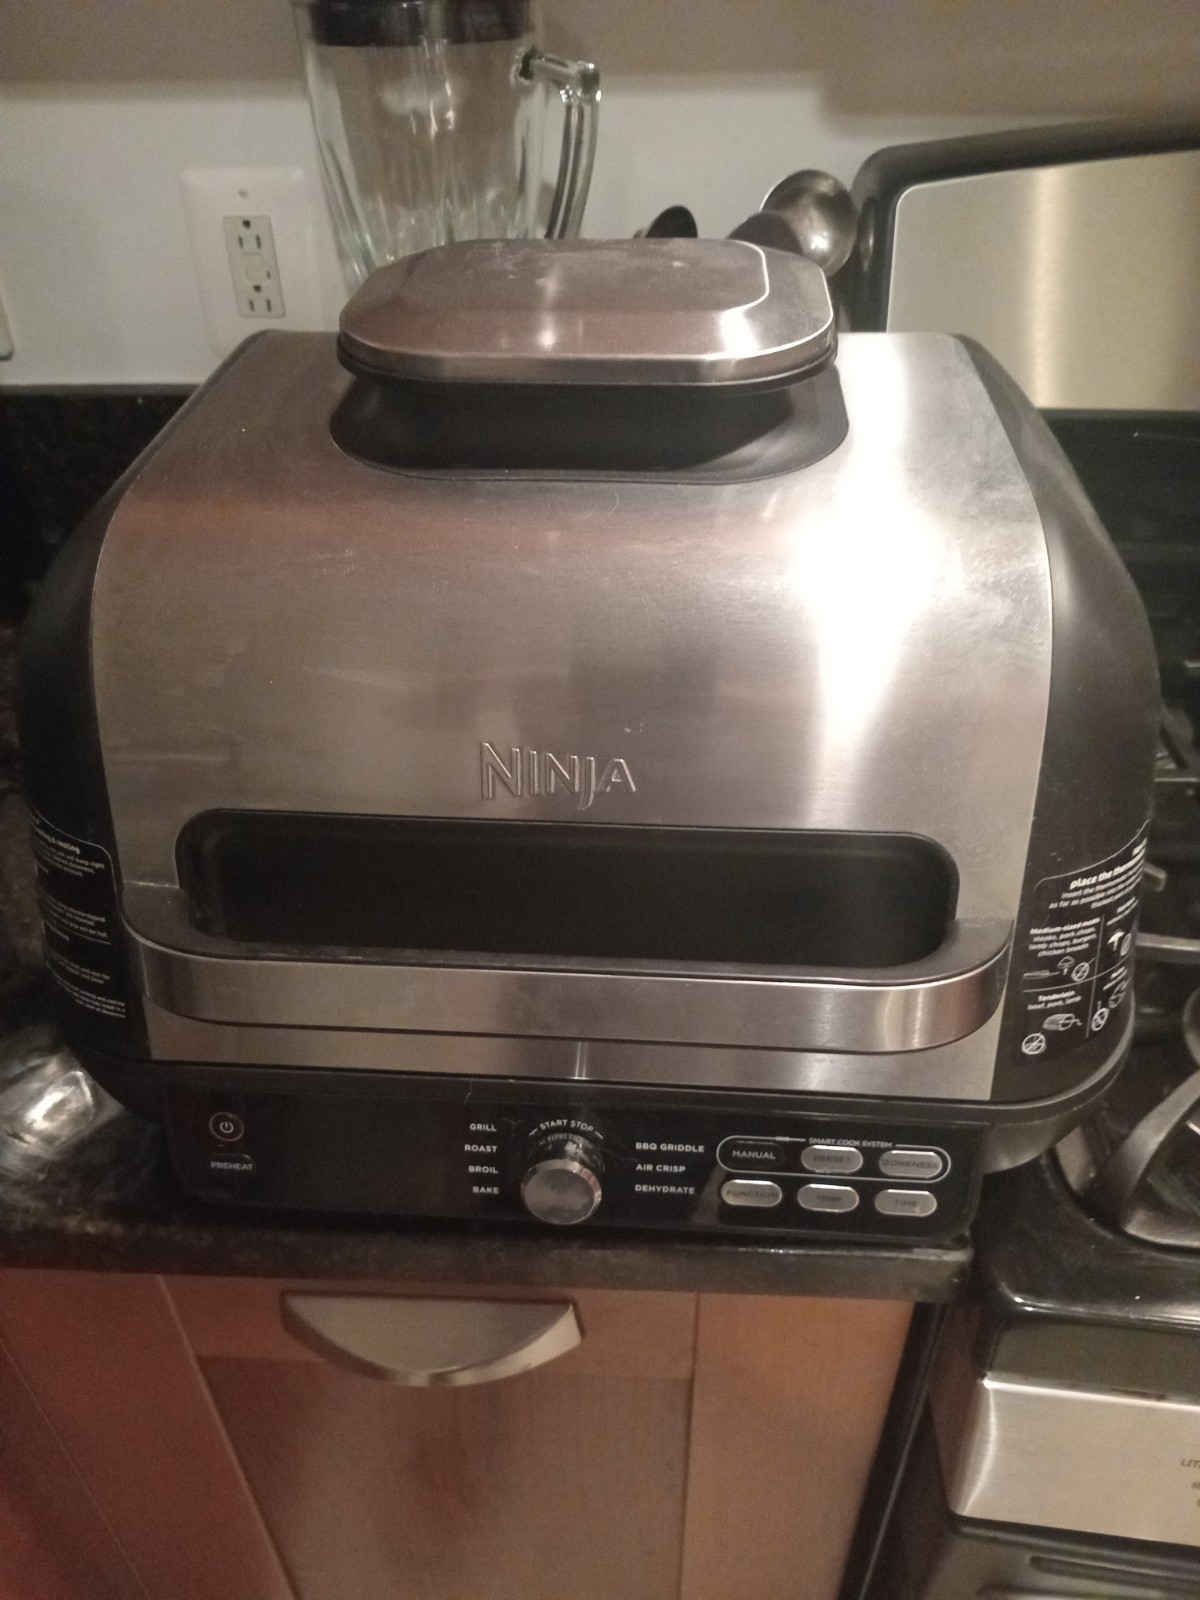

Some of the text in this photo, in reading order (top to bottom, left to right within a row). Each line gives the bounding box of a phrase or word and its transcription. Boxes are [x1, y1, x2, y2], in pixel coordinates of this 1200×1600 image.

[481, 742, 637, 811] NINJA
[469, 1123, 497, 1132] GRILL
[540, 1119, 594, 1132] START STOP
[635, 1142, 705, 1153] BBQ GRIDDLE
[809, 1137, 893, 1148] SMART COOK SYSTEM
[464, 1144, 498, 1153] ROAST
[732, 1150, 776, 1160] MANUAL
[812, 1154, 851, 1164] PRESET
[210, 1161, 253, 1170] PREHEAT
[635, 1164, 686, 1173] AIR CRISP
[882, 1159, 938, 1169] DONENESS
[468, 1165, 499, 1174] BROIL
[472, 1185, 499, 1195] BAKE
[635, 1184, 695, 1195] DEHYDRATE
[726, 1189, 778, 1199] FUNCTION
[894, 1199, 918, 1208] TIME
